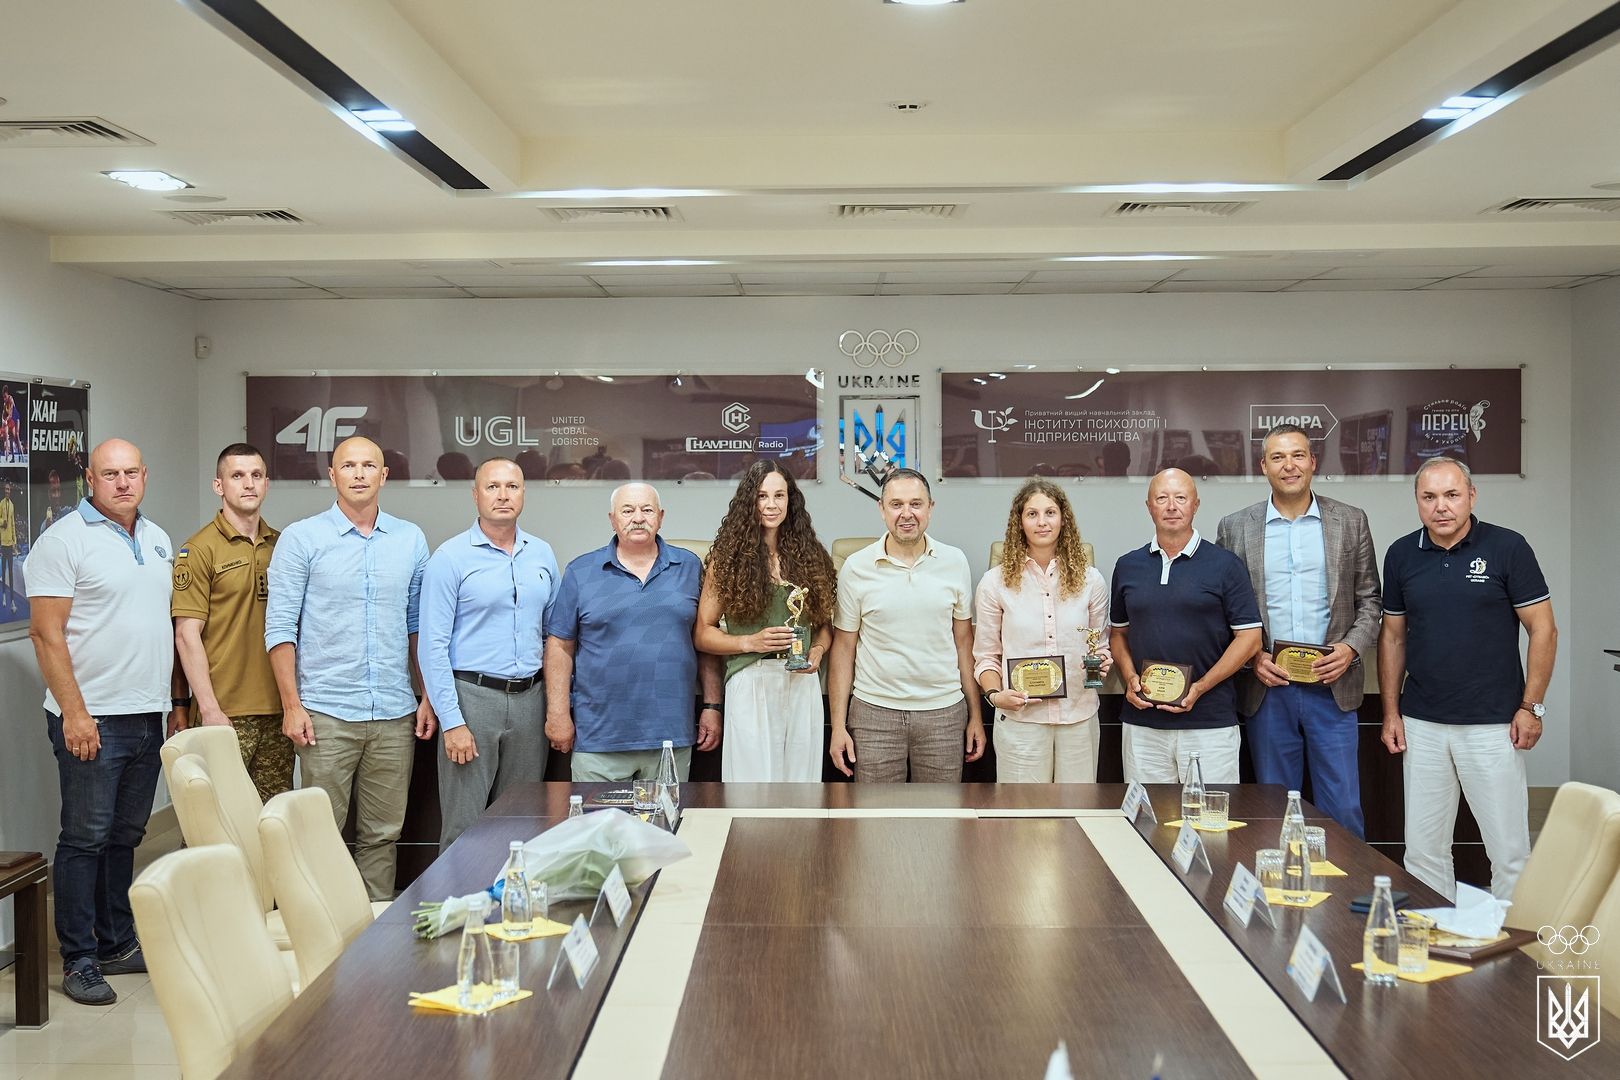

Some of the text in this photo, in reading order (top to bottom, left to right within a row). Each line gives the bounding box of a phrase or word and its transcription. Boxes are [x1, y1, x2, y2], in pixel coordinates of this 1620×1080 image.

[838, 375, 920, 388] UKRAINE
[31, 400, 58, 423] ЖАН
[551, 416, 586, 424] UNITED
[1024, 418, 1083, 429] ІНСТИТУТ
[1087, 417, 1161, 429] ПСИХОЛОГІЇ
[1257, 415, 1323, 431] ЦИФРА
[1421, 413, 1470, 433] ПЕРЕЦ
[275, 406, 369, 452] 4F
[455, 416, 540, 447] UGL
[551, 427, 588, 435] GLOBAL
[551, 437, 600, 446] LOGISTICS
[1024, 431, 1140, 443] ПІДПРИЄМНИЦТВА
[686, 437, 784, 452] CHAMPION Radio
